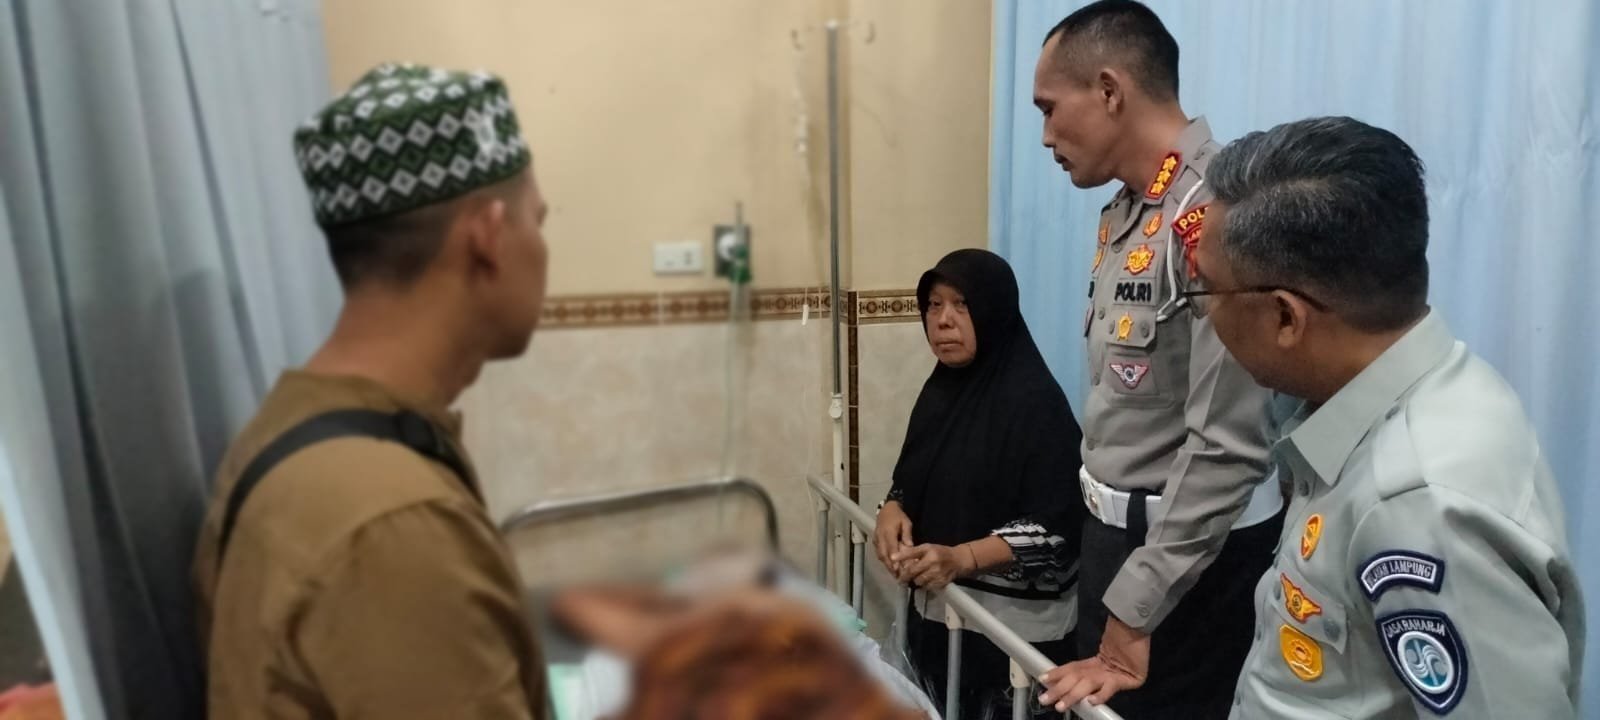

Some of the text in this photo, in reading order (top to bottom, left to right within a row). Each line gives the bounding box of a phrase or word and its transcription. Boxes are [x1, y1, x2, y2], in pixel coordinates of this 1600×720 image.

[1179, 206, 1208, 230] POL
[1114, 282, 1151, 302] POLRI
[1389, 560, 1431, 577] LAMPUNG
[1385, 619, 1446, 638] JASA RAHARJA
